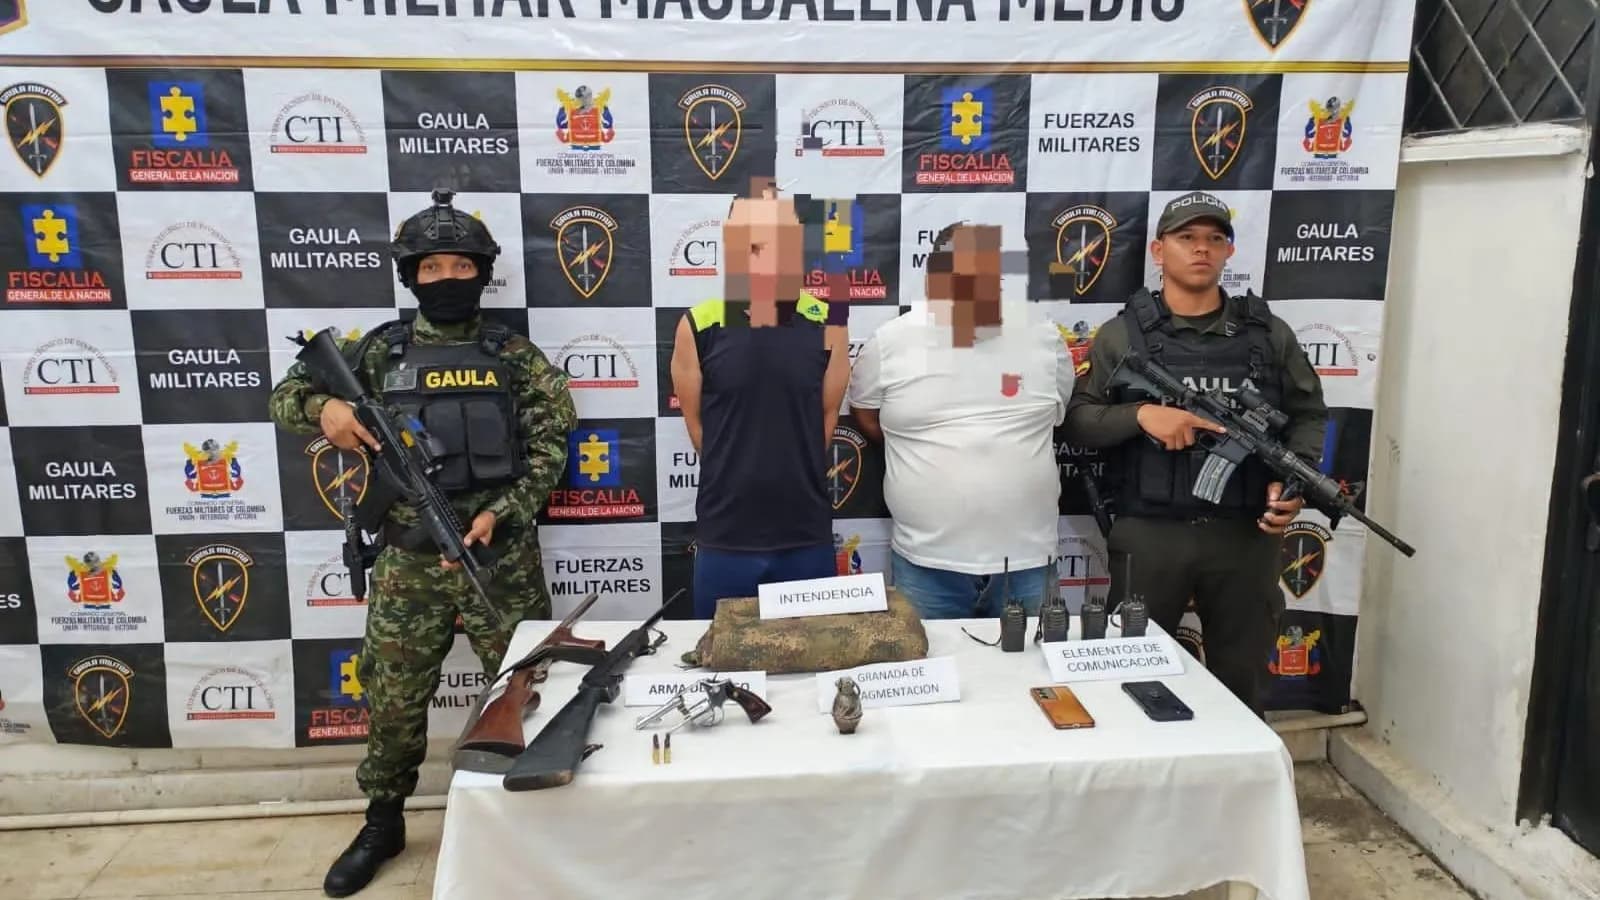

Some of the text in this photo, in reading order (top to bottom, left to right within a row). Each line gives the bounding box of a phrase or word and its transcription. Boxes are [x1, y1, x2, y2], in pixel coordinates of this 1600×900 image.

[284, 115, 344, 143] CTI
[417, 112, 490, 130] GAULA
[1044, 112, 1135, 129] FUERZAS
[810, 119, 865, 146] CTI
[399, 137, 510, 155] MILITARES
[1038, 136, 1140, 153] MILITARES
[132, 151, 233, 167] FISCALIA
[920, 153, 1012, 170] FISCALIA
[131, 171, 239, 181] GENERAL DE LA NACION
[916, 172, 1013, 183] GENERAL DE LA NACION
[289, 228, 361, 245] GAULA
[1296, 223, 1359, 239] GAULA
[161, 242, 219, 269] CTI
[270, 252, 381, 269] MILITARES
[684, 240, 718, 266] CT
[1277, 246, 1375, 263] MILITARES
[9, 271, 105, 288] FISCALIA
[7, 290, 111, 300] GENERAL DE LA NACION
[167, 348, 241, 365] GAULA
[37, 358, 96, 385] CTI
[564, 354, 616, 379] CTI
[149, 371, 261, 389] MILITARES
[426, 370, 499, 388] GAULA
[1182, 376, 1260, 393] AULA
[45, 461, 117, 478] GAULA
[28, 483, 137, 500] MILITARES
[551, 490, 640, 505] FISCALIA
[549, 505, 644, 516] GENERAL DE LA NACION
[555, 557, 644, 575] FUERZAS
[551, 579, 650, 596] MILITARES
[780, 586, 874, 604] INTENDENCIA
[1062, 643, 1162, 659] ELEMENTOS DE
[1067, 656, 1170, 673] COMUNICACION
[439, 672, 490, 688] FUER
[857, 666, 926, 682] GRANADA DE
[201, 686, 256, 711] CTI
[861, 683, 940, 700] AGMENTACION
[312, 709, 369, 726] FISCA
[310, 729, 347, 738] GENERAL
[349, 728, 362, 737] DE
